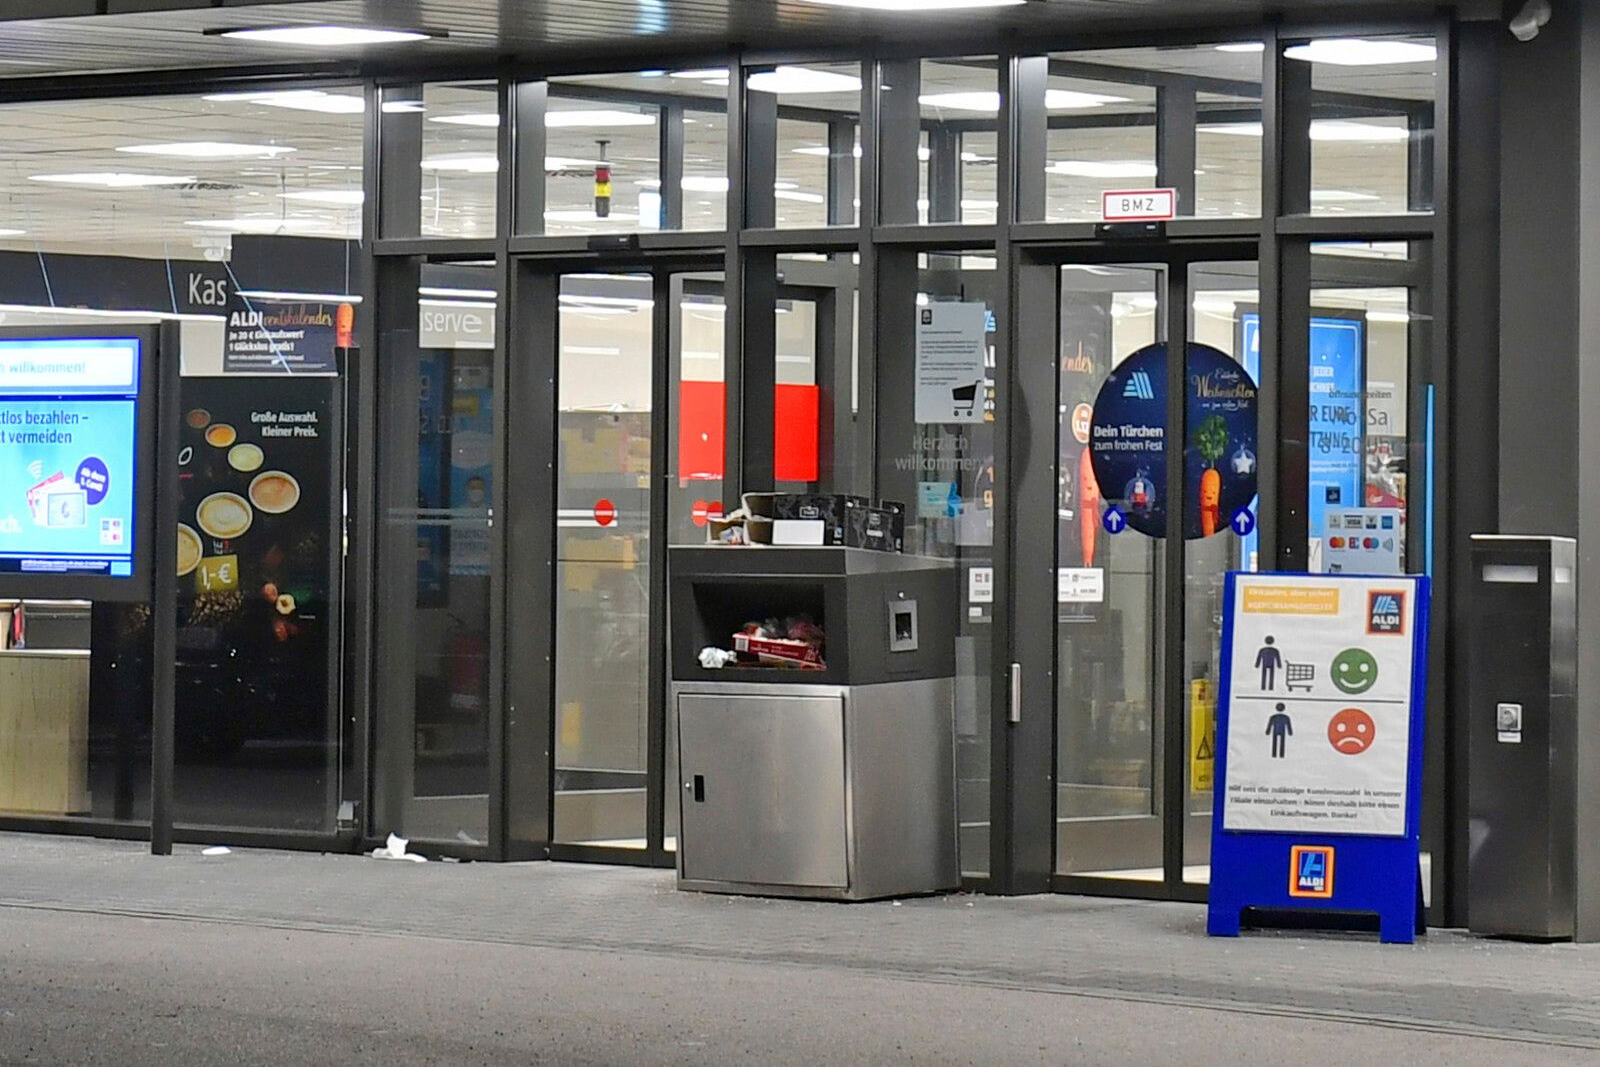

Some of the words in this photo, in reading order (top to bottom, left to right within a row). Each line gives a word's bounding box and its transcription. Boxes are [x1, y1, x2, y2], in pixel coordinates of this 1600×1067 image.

[1122, 198, 1153, 211] BMZ
[9, 361, 86, 374] willkommen!
[25, 410, 78, 424] bezahlen
[251, 412, 277, 422] Große
[278, 411, 318, 422] Auswahl.
[1368, 408, 1388, 425] Sa
[9, 429, 72, 443] vermeiden
[262, 426, 292, 437] Kleiner
[294, 426, 318, 437] Preis.
[1094, 425, 1117, 438] Dein
[1120, 424, 1163, 438] Türchen
[913, 434, 968, 451] Herzlich
[1094, 441, 1112, 451] zum
[1114, 439, 1143, 450] frohen
[1145, 440, 1163, 451] Fest
[1372, 615, 1399, 625] ALDI
[1299, 876, 1324, 886] ALDI
